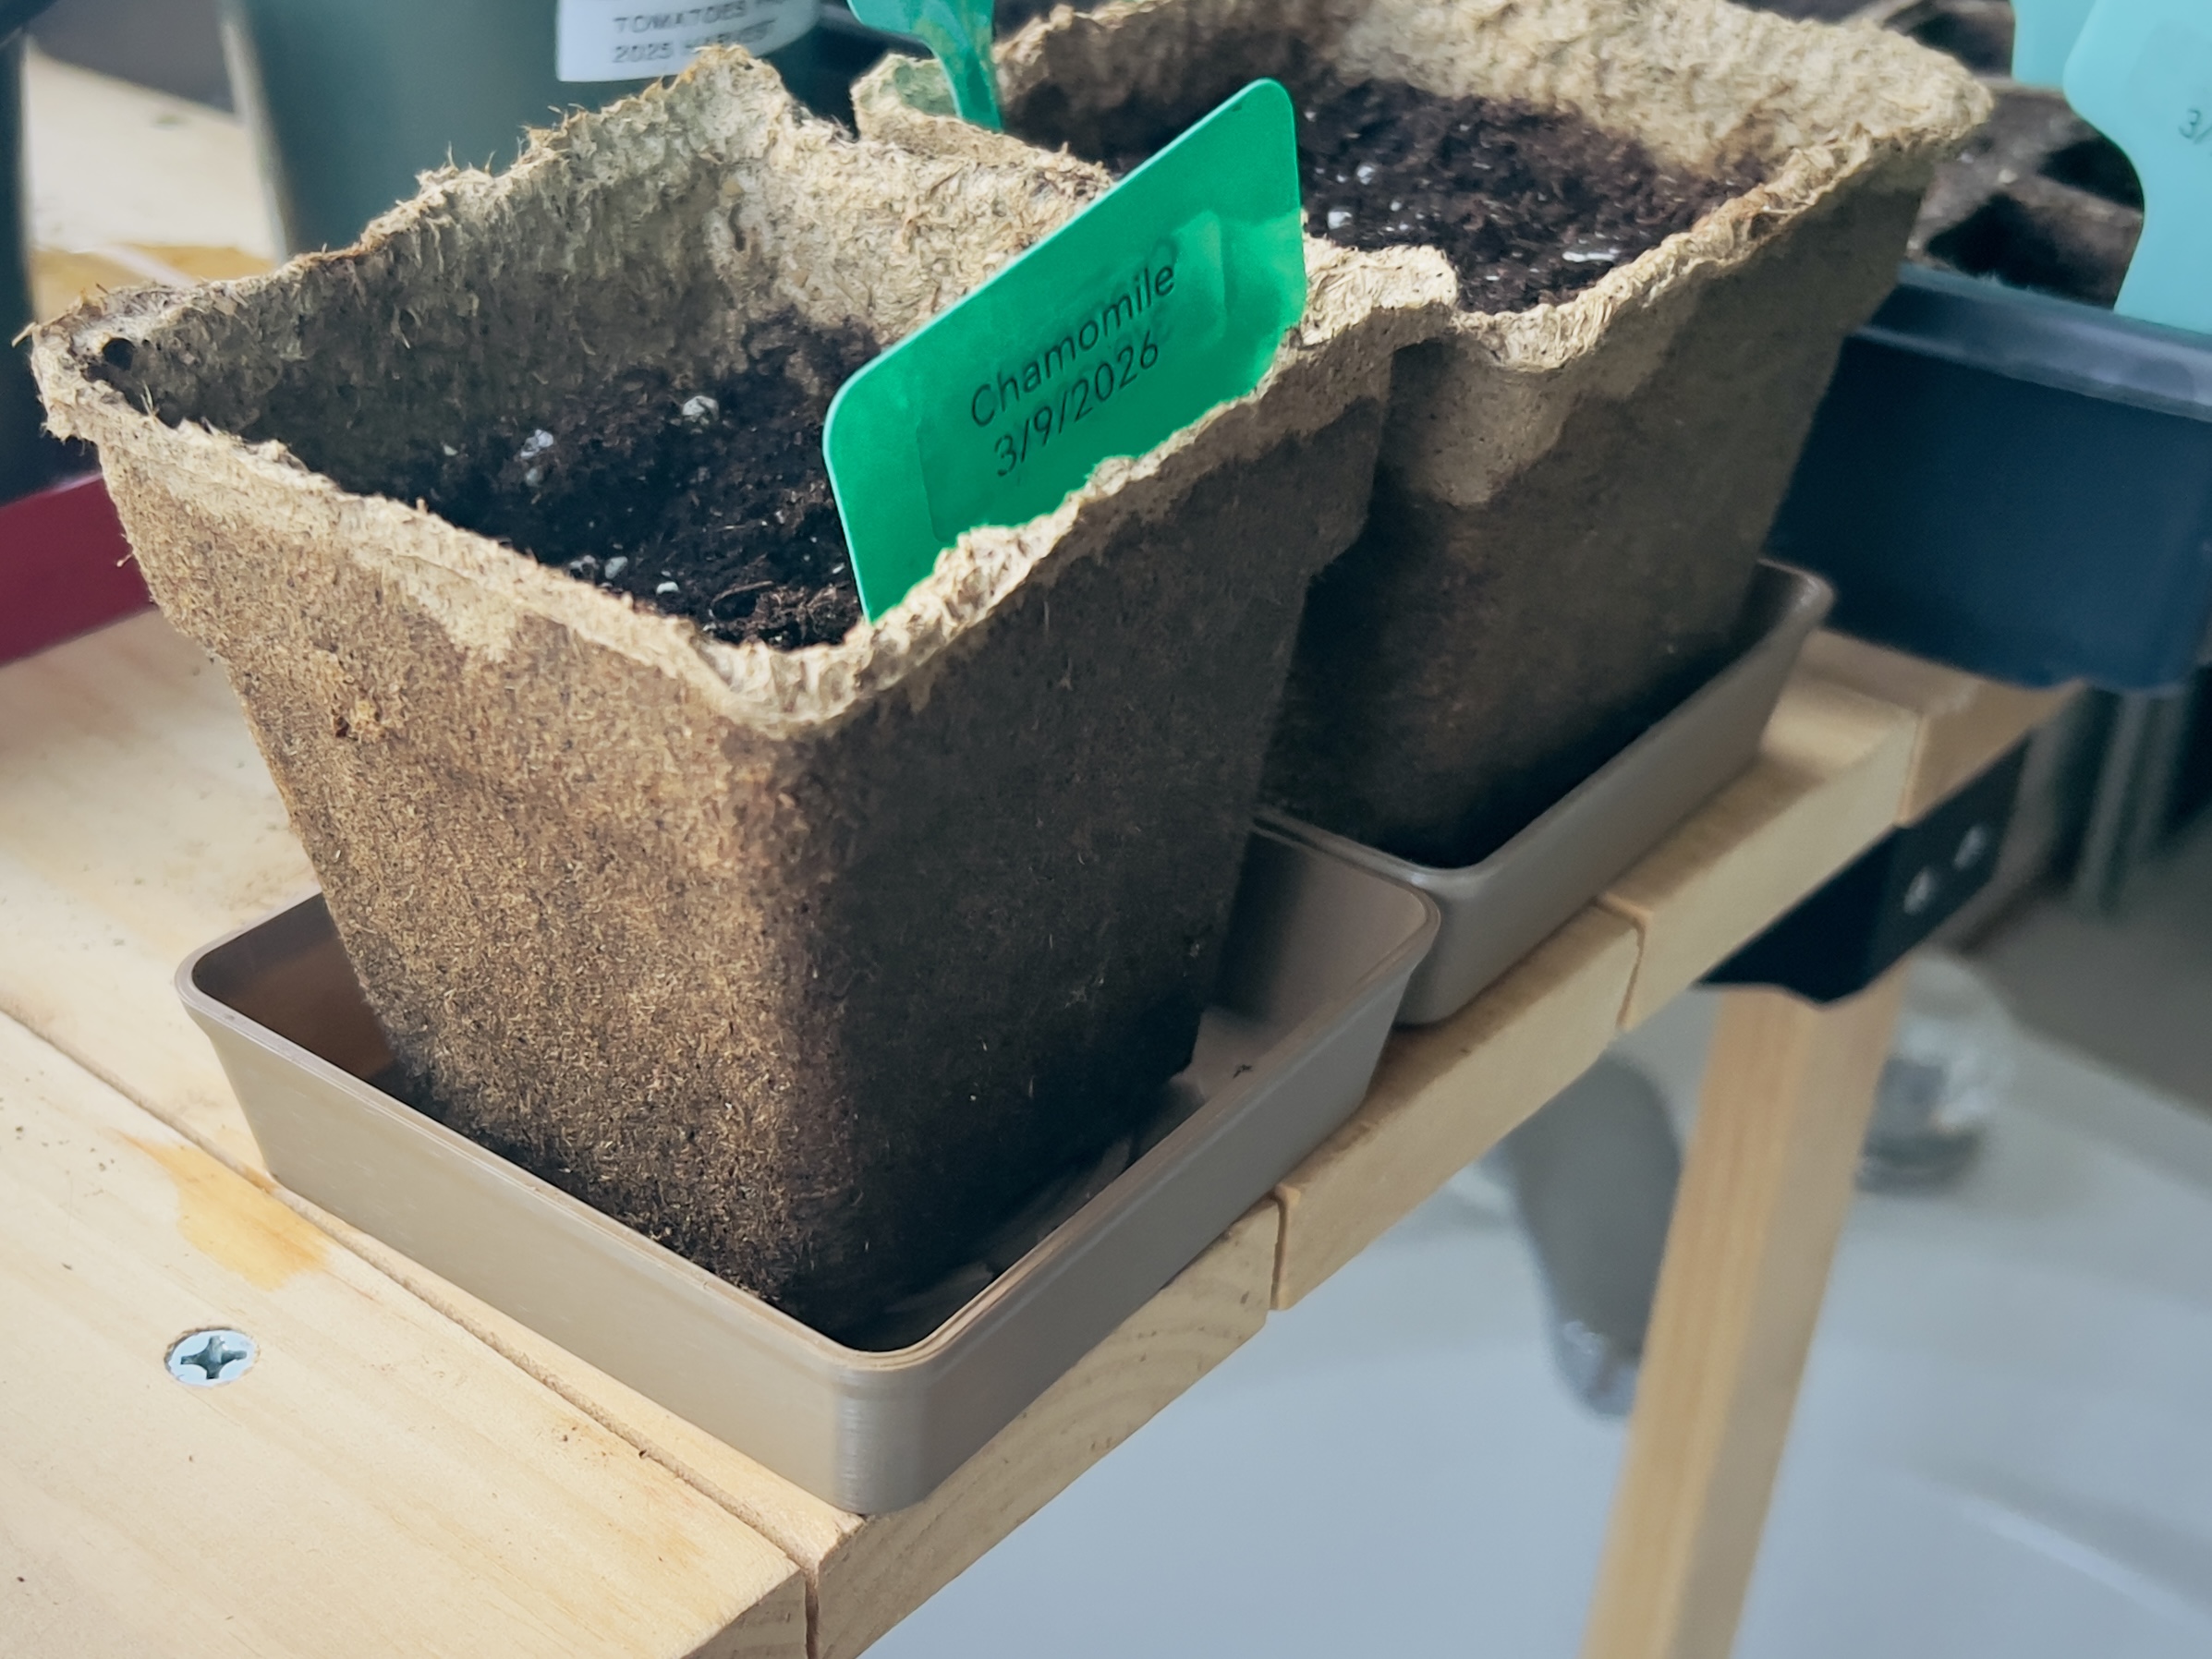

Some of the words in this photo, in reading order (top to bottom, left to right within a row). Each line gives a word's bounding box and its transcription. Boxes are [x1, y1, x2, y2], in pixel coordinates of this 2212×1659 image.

[612, 42, 674, 64] 2025
[613, 1, 747, 33] TOMATOES
[971, 265, 1174, 427] Chamomile
[994, 329, 1159, 477] 3/9/2026
